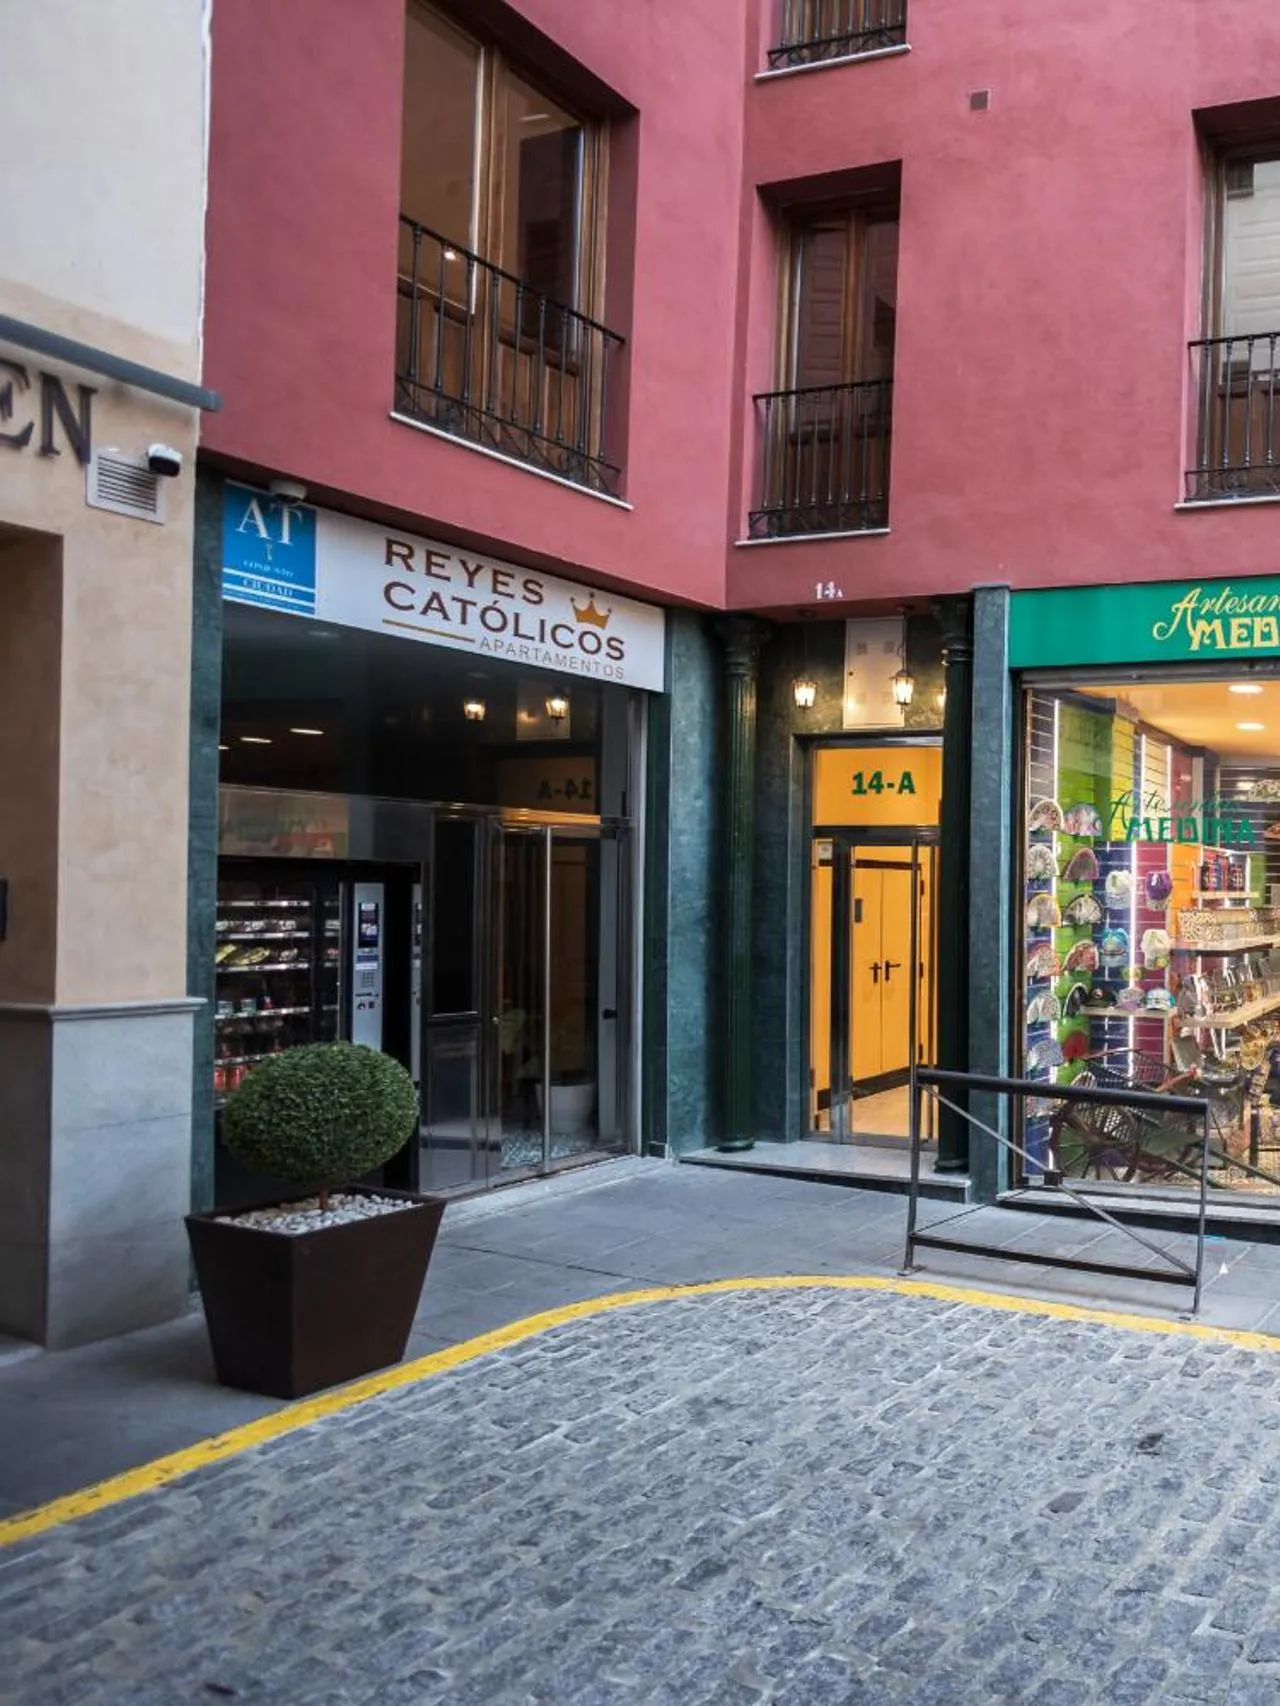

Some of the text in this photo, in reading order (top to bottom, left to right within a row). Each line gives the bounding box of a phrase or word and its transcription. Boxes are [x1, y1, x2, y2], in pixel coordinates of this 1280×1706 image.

[235, 498, 304, 546] AT
[384, 537, 545, 605] REYES
[383, 581, 626, 661] CATÓLICOS
[480, 635, 625, 681] APARTAMENTOS
[851, 771, 916, 795] 14-A
[1126, 815, 1256, 847] MEDINA
